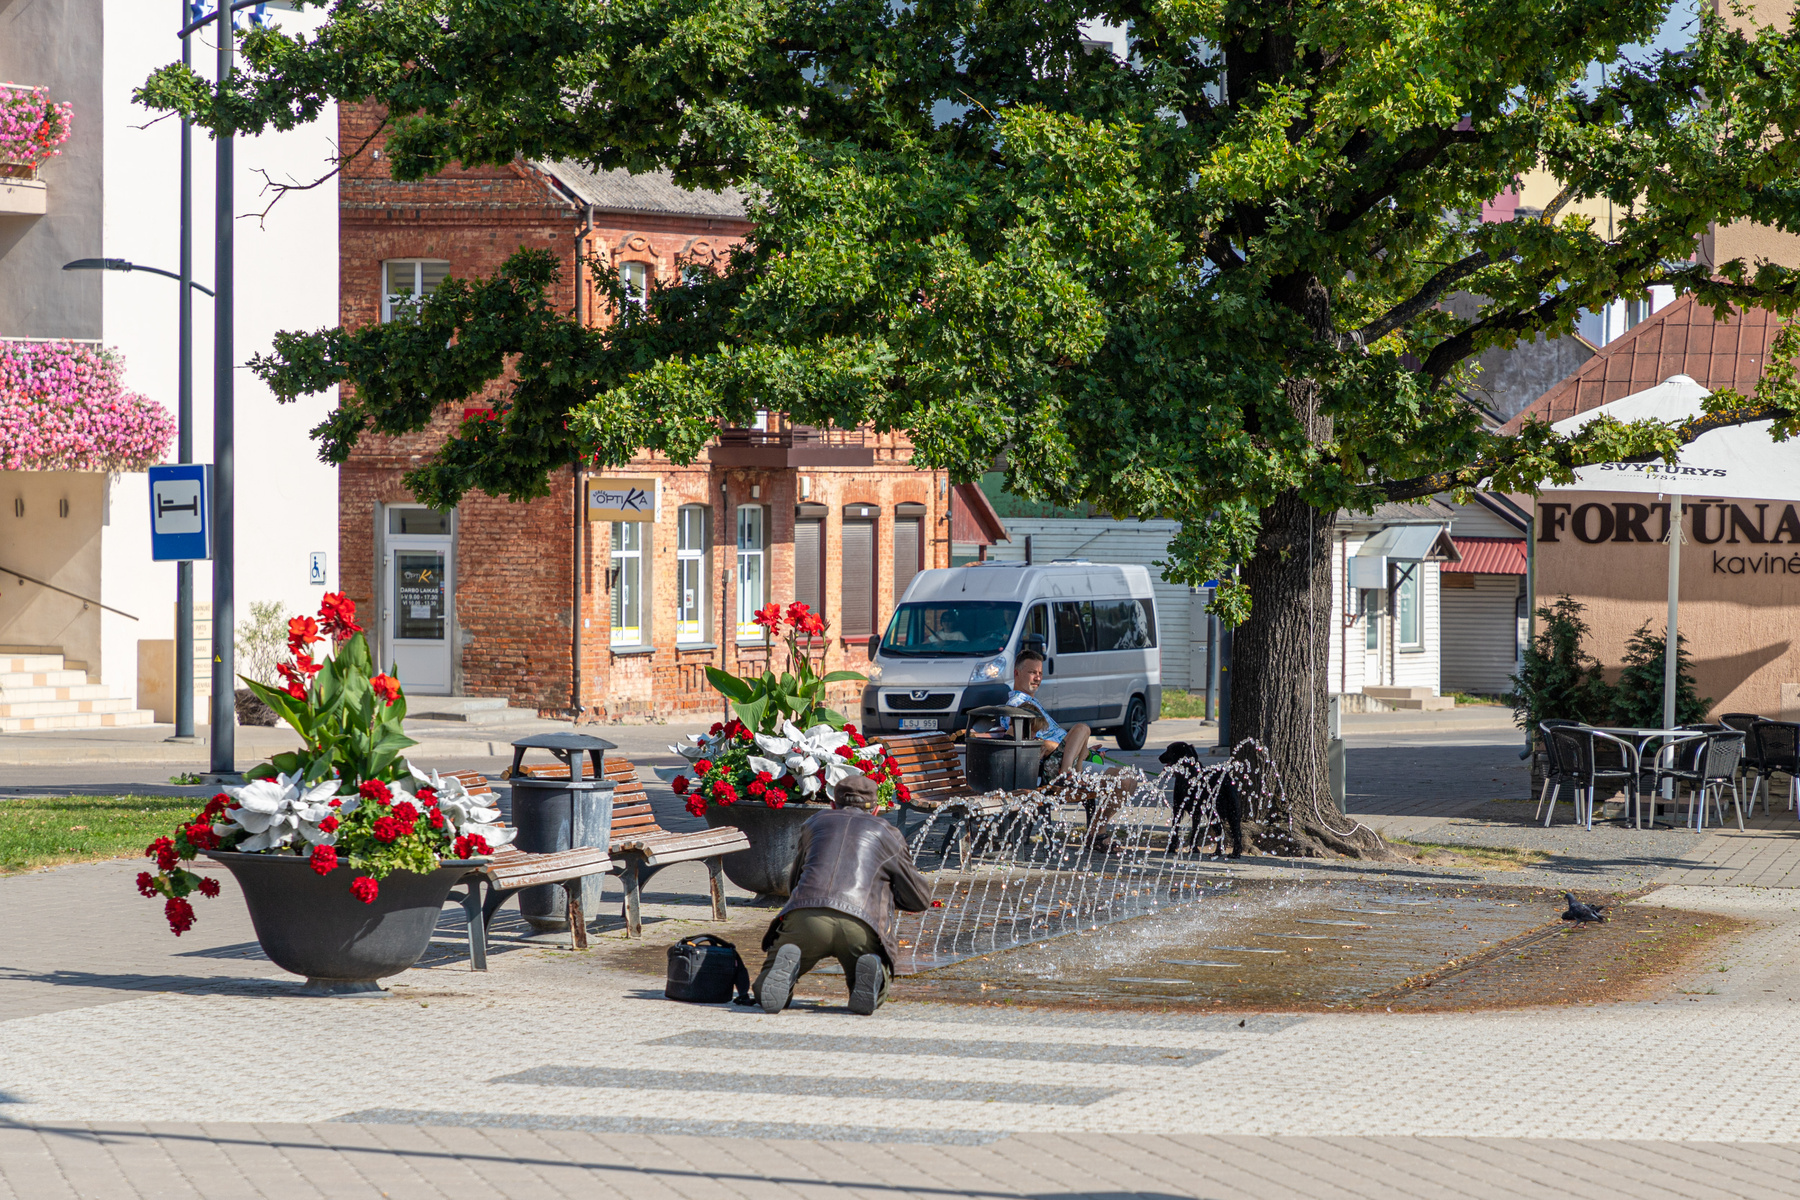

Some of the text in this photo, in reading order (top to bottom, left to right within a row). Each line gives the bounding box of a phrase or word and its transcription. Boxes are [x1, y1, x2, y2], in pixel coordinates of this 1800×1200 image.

[1646, 473, 1677, 481] 1784
[596, 487, 648, 513] OPTIKA
[1537, 498, 1800, 544] FORTŪNA
[1713, 550, 1800, 574] kavinė
[405, 569, 434, 584] OPTIKA
[923, 720, 937, 728] 959
